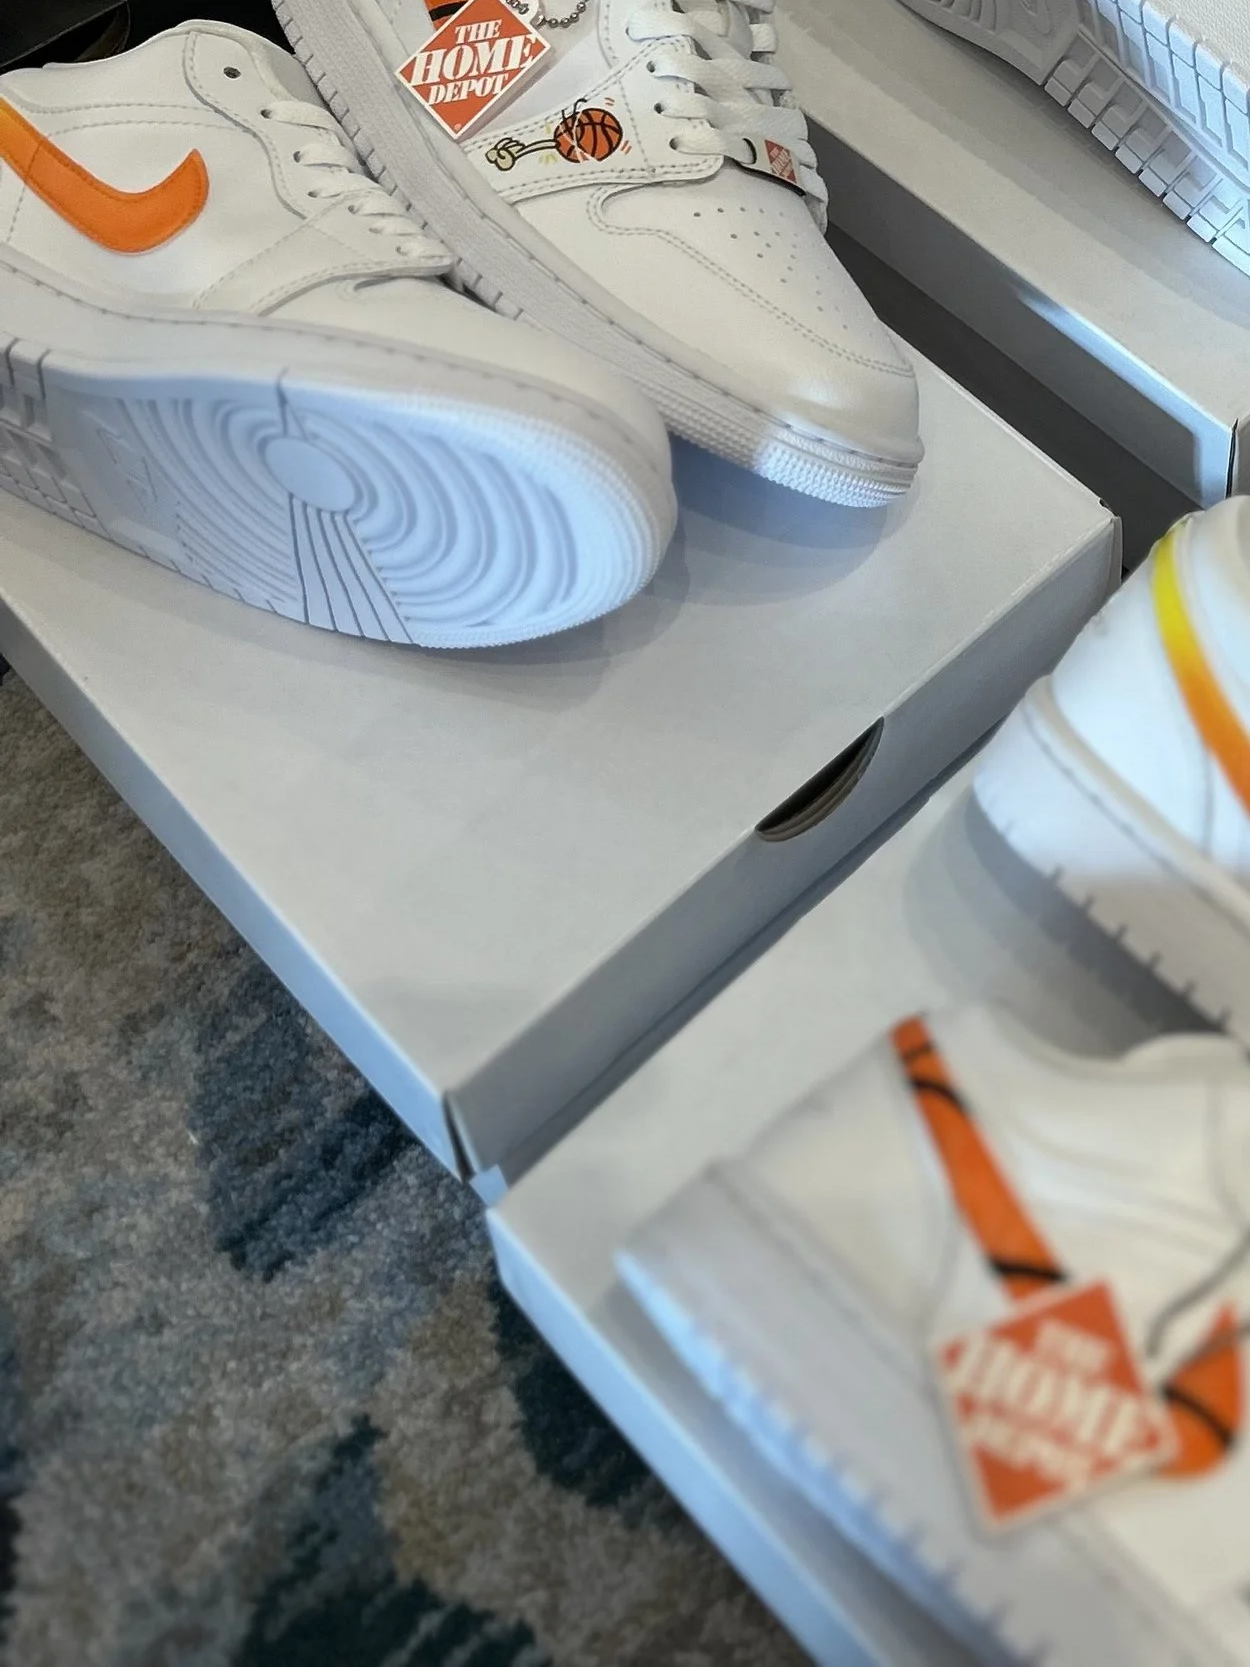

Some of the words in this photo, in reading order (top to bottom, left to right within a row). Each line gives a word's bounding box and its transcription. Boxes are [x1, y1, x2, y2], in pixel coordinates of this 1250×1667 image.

[454, 19, 502, 44] THE
[411, 33, 538, 85] HOME
[428, 74, 509, 105] DEPOT
[951, 1334, 1157, 1468] HOME
